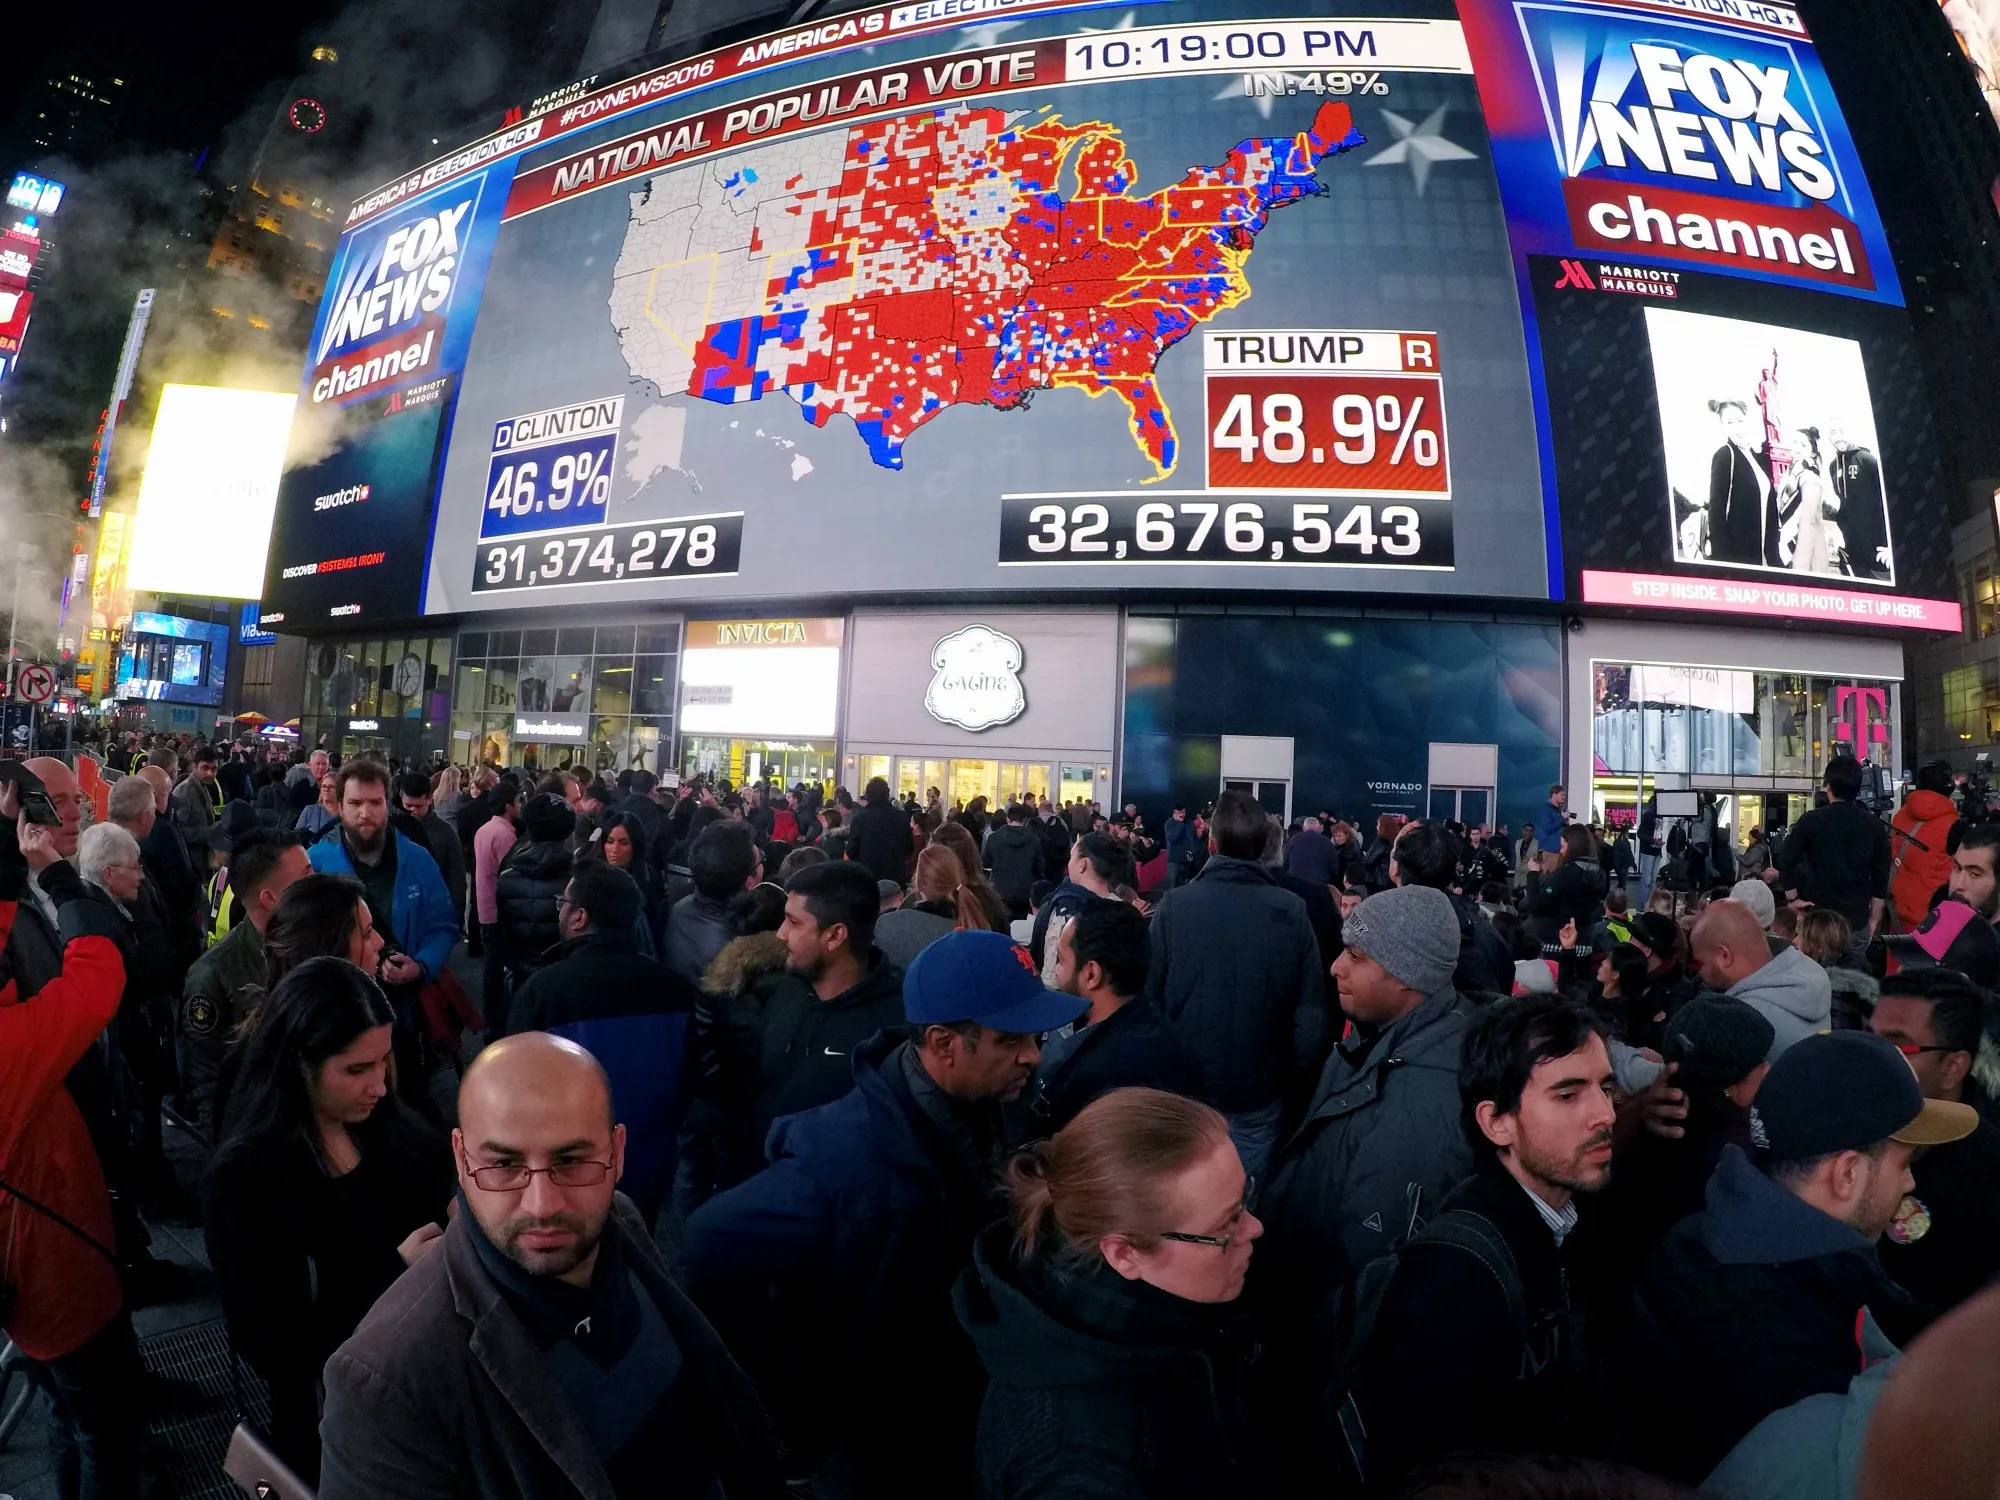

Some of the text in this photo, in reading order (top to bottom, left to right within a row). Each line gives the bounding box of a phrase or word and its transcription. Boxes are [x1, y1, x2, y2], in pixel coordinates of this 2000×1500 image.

[1747, 3, 1783, 25] HQ
[737, 13, 885, 66] AMERICA'S
[1074, 30, 1378, 71] 10:19:00 PM
[528, 89, 587, 118] MARQUIS
[532, 75, 598, 107] MARRIOTT
[560, 59, 715, 127] #FOXNEWS2016
[1629, 42, 1814, 135] FOX
[552, 50, 1036, 197] NATIONAL POPULAR VOTE
[1589, 100, 1836, 201] NEWS
[346, 128, 527, 225] AMERICA'S ELECTION HQ
[375, 200, 472, 285] FOX
[1588, 195, 1855, 276] channel
[1600, 264, 1680, 284] MARRIOTT
[1602, 278, 1675, 296] MARQUIS
[333, 256, 456, 349] NEWS
[312, 330, 435, 404] channel
[1213, 336, 1434, 368] TRUMP R
[404, 391, 440, 407] MARQUIS
[406, 378, 447, 397] MARRIOTT
[495, 401, 617, 448] D CLINTON
[1213, 393, 1438, 467] 48.9%
[314, 484, 362, 512] swatch
[488, 449, 610, 519] 46.9%
[1027, 503, 1421, 560] 32,676,543
[282, 563, 318, 579] DISCOVER
[358, 552, 385, 567] IRONY
[485, 524, 717, 586] 31,374,278
[330, 604, 357, 617] swatch
[1631, 580, 1927, 620] STEP INSIDE. SNAP YOUR PHOTO. GET UP HERE.
[717, 622, 807, 644] INVICTA
[516, 719, 582, 736] Brookstone
[1367, 781, 1422, 791] VORNADO
